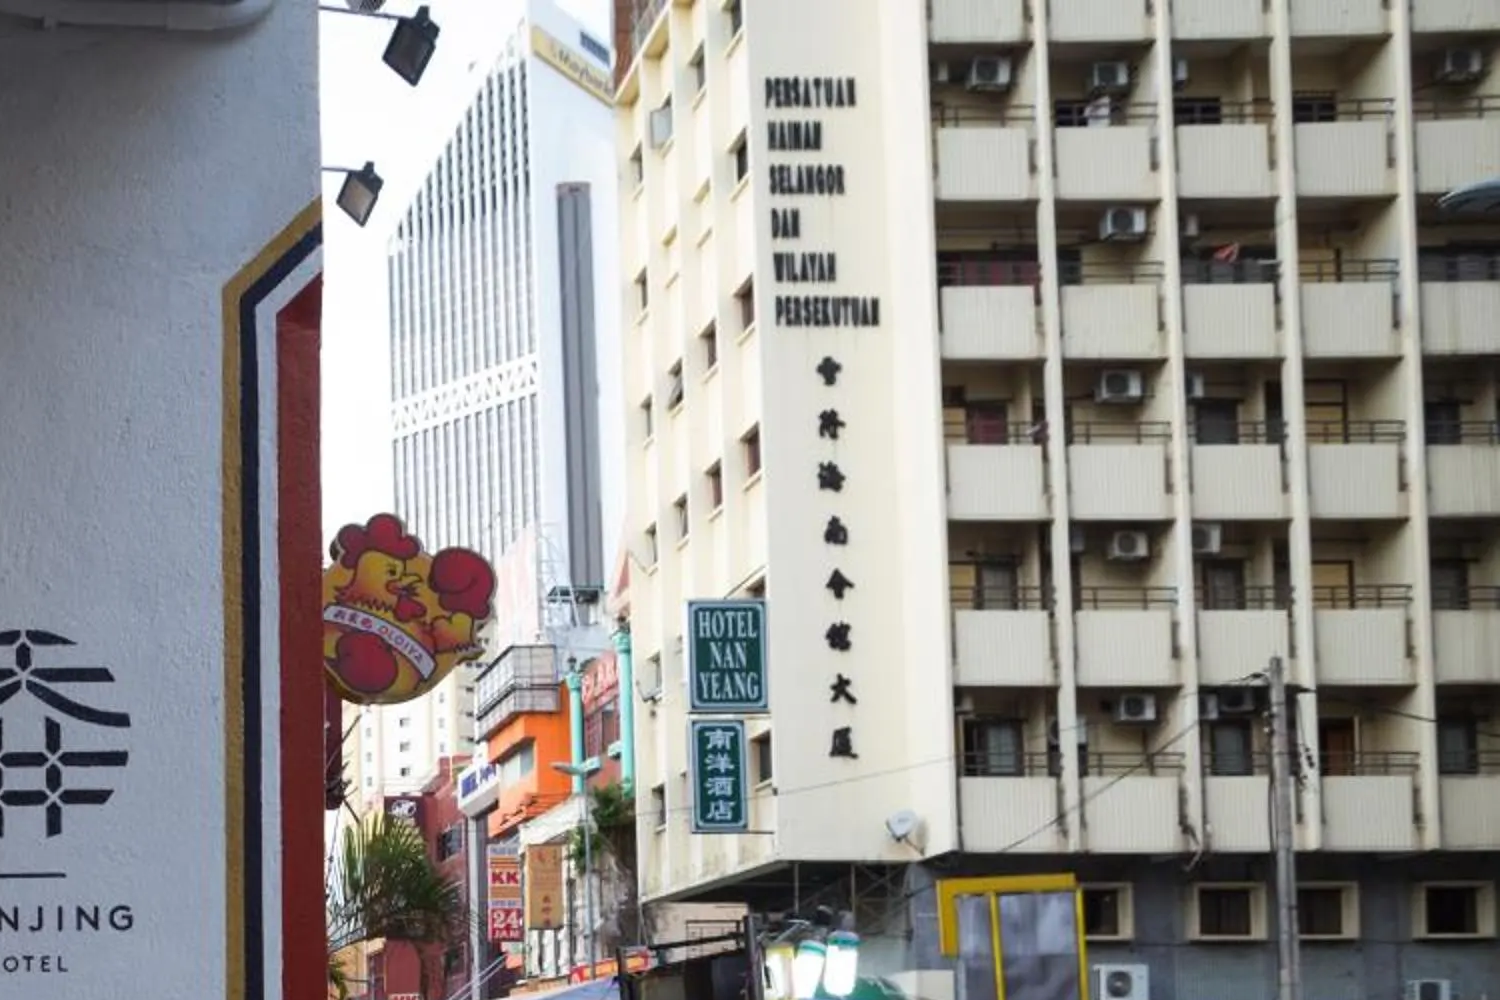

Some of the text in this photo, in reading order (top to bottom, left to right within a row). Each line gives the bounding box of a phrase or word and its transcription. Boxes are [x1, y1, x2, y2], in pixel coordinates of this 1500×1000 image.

[764, 76, 857, 108] PERSATUAN
[767, 120, 822, 151] HAINAN
[769, 164, 845, 195] SELANGOR
[771, 208, 800, 239] DAN
[773, 252, 836, 283] WILAYAH
[775, 295, 880, 327] PERSEKUTUAN
[698, 611, 758, 638] HOTEL
[710, 641, 748, 669] NAN
[699, 672, 760, 700] YEANG
[704, 729, 736, 821] 南洋酒店
[491, 871, 519, 885] KK
[493, 910, 519, 929] 24
